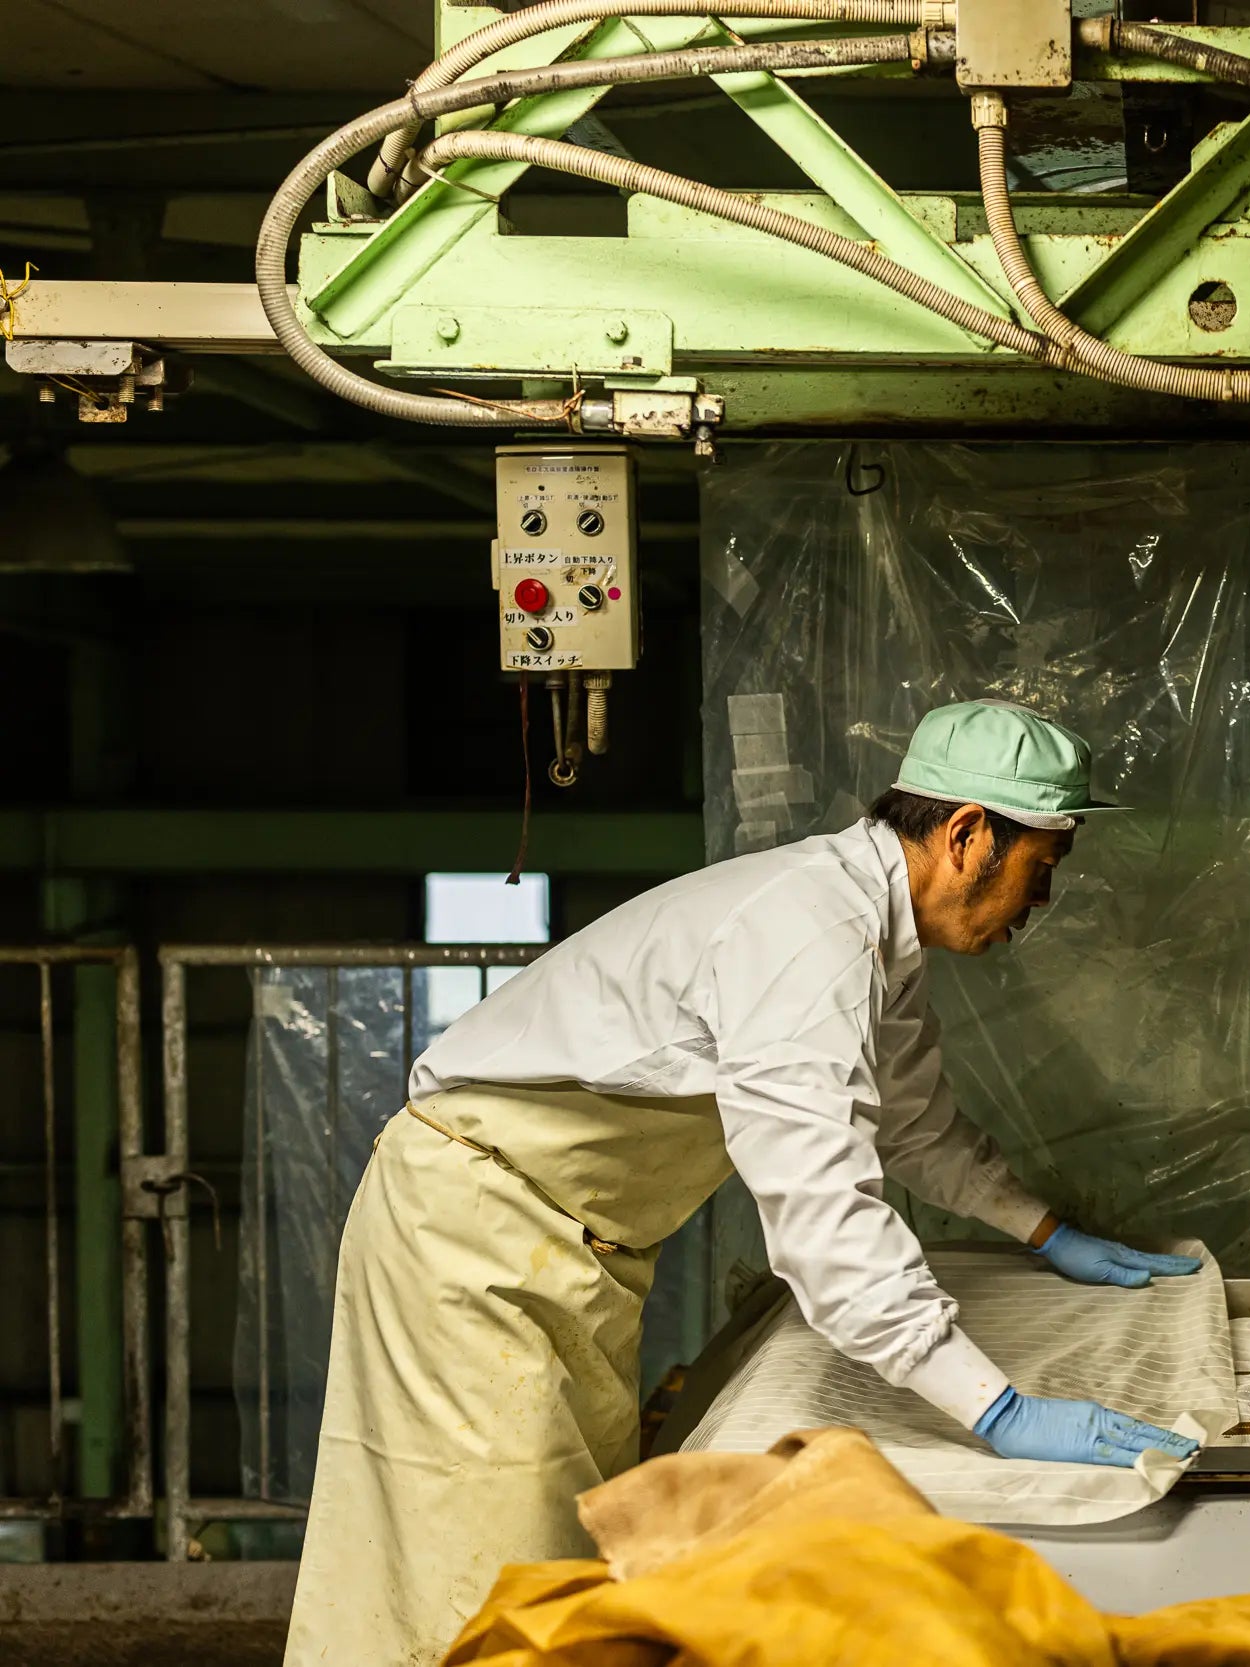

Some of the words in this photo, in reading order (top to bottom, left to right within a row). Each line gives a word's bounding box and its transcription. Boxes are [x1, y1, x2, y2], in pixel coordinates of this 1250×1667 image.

[505, 553, 558, 564] 上昇ボタン
[565, 556, 613, 564] 自動下降入り
[580, 567, 596, 575] 下降
[504, 613, 525, 624] 切り
[552, 611, 573, 622] 入り
[512, 655, 579, 666] 下降スイッチ
